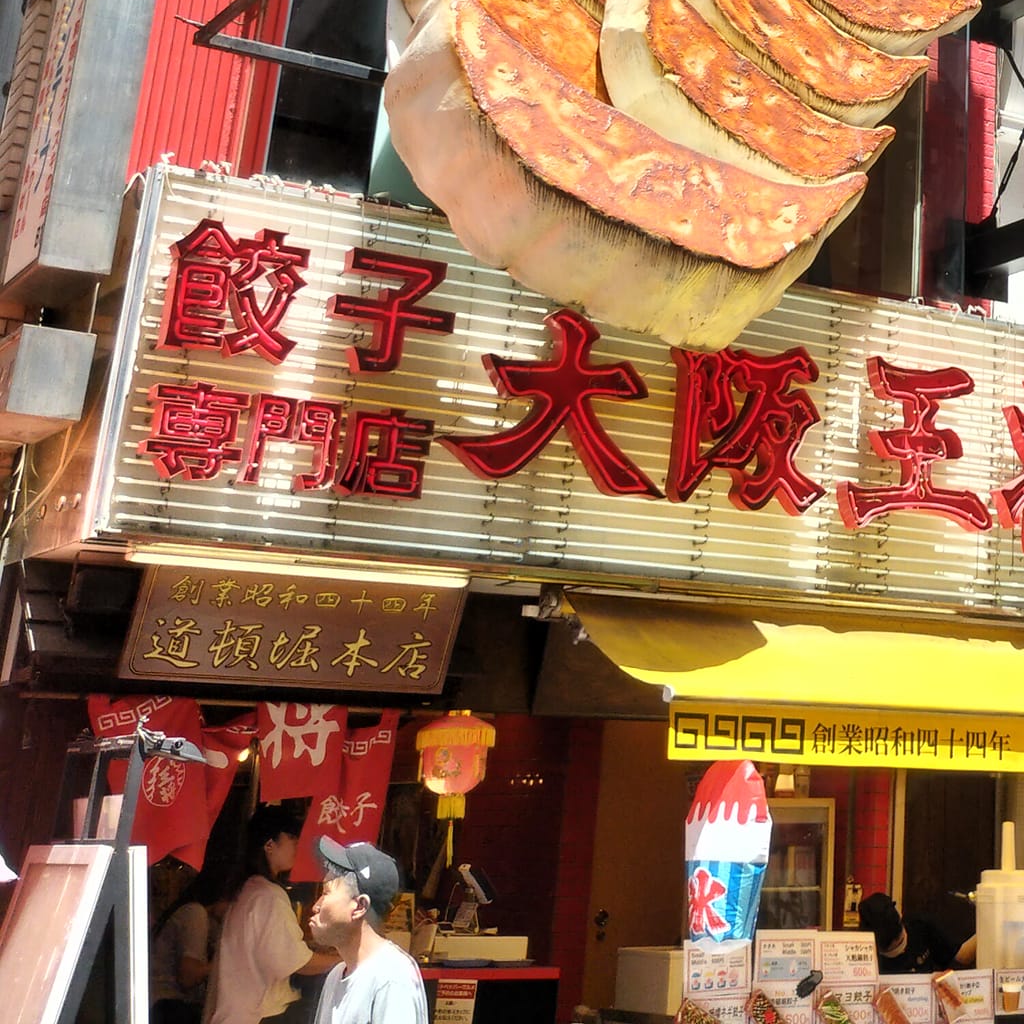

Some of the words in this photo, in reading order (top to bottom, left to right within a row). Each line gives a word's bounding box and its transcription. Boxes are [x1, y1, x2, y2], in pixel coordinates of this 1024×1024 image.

[155, 217, 456, 375] 餃子
[170, 575, 441, 621] 創業昭和四十四年
[143, 617, 432, 680] 道頓堀本店
[811, 722, 1012, 762] 創業昭和四十四年
[316, 792, 378, 834] 餃子
[688, 867, 733, 937] 氷
